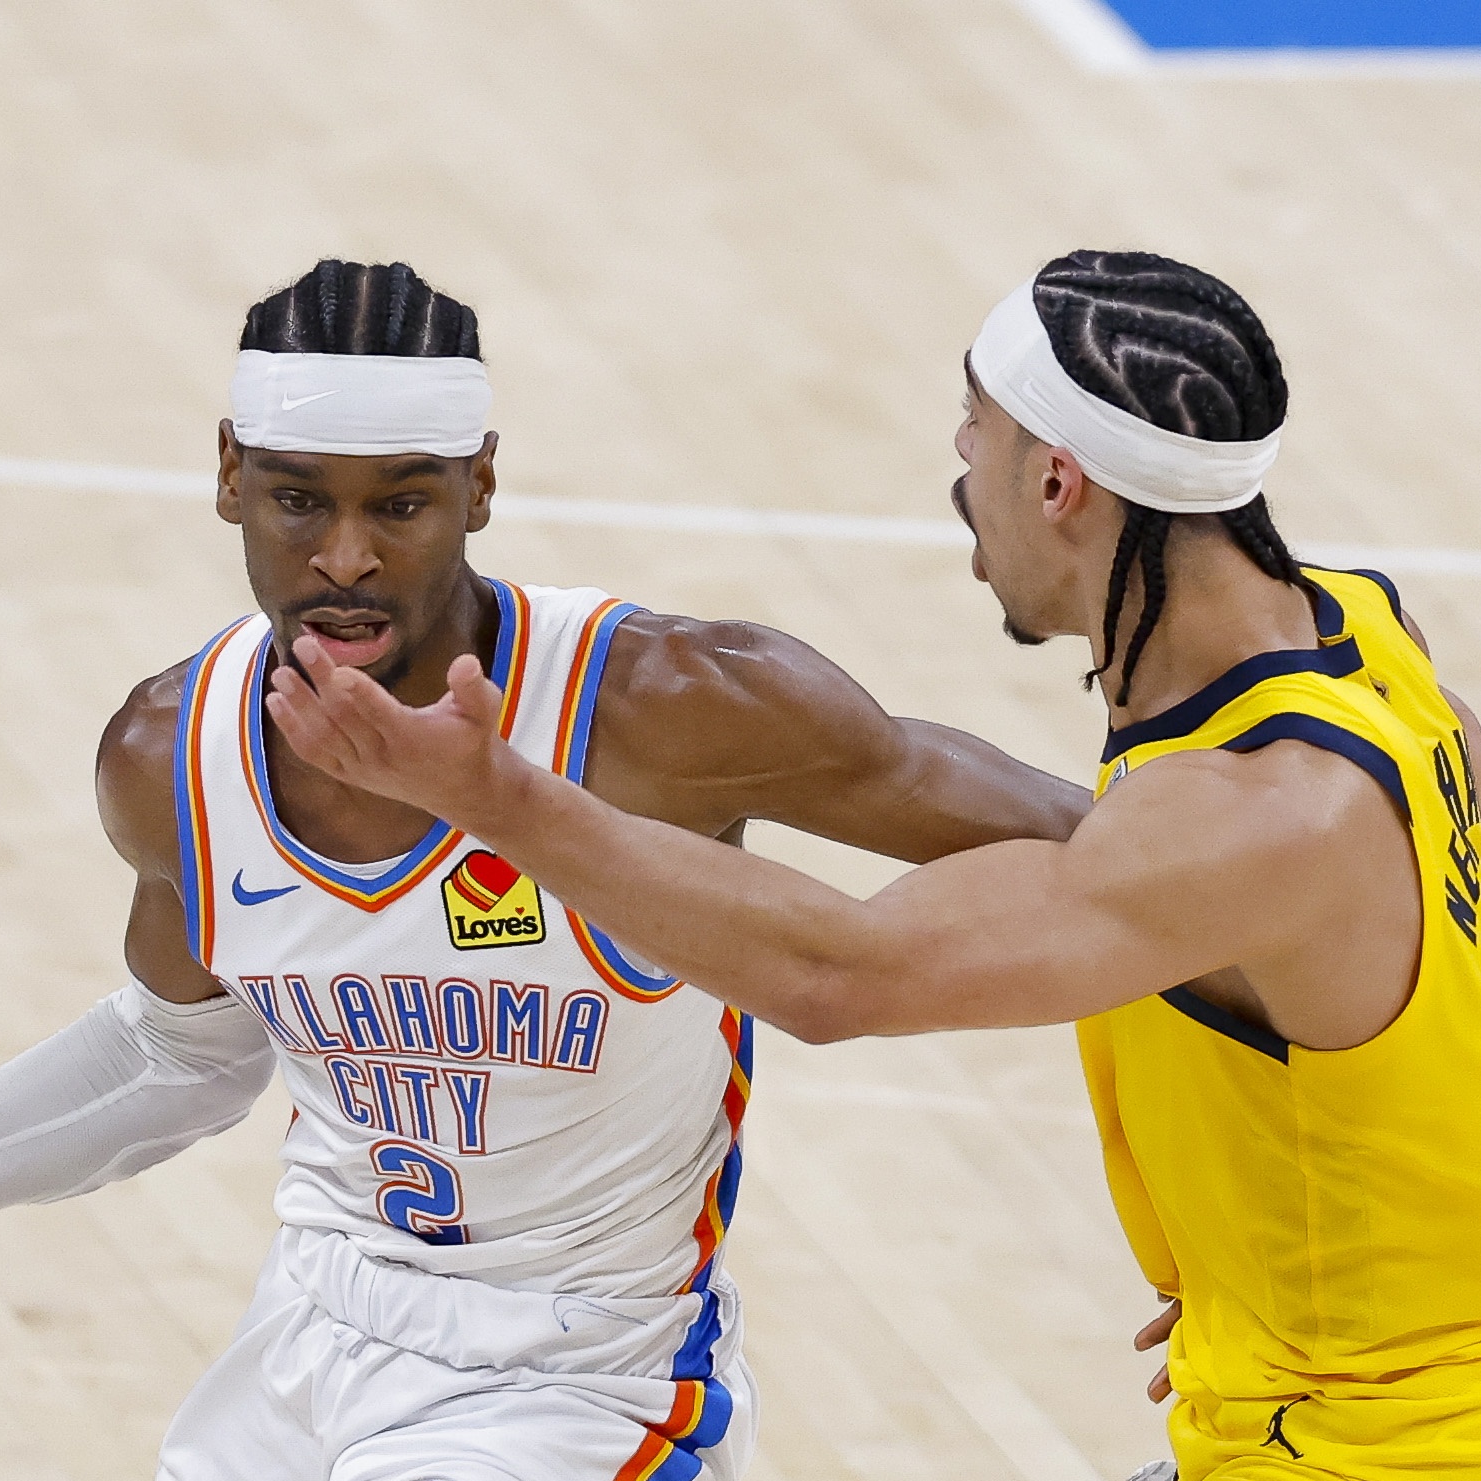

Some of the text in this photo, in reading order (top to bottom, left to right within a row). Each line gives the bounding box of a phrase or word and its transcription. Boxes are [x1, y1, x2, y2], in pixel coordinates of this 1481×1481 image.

[218, 973, 610, 1074] KLAHOMA
[323, 1053, 492, 1155] CITY
[369, 1140, 470, 1246] 2
